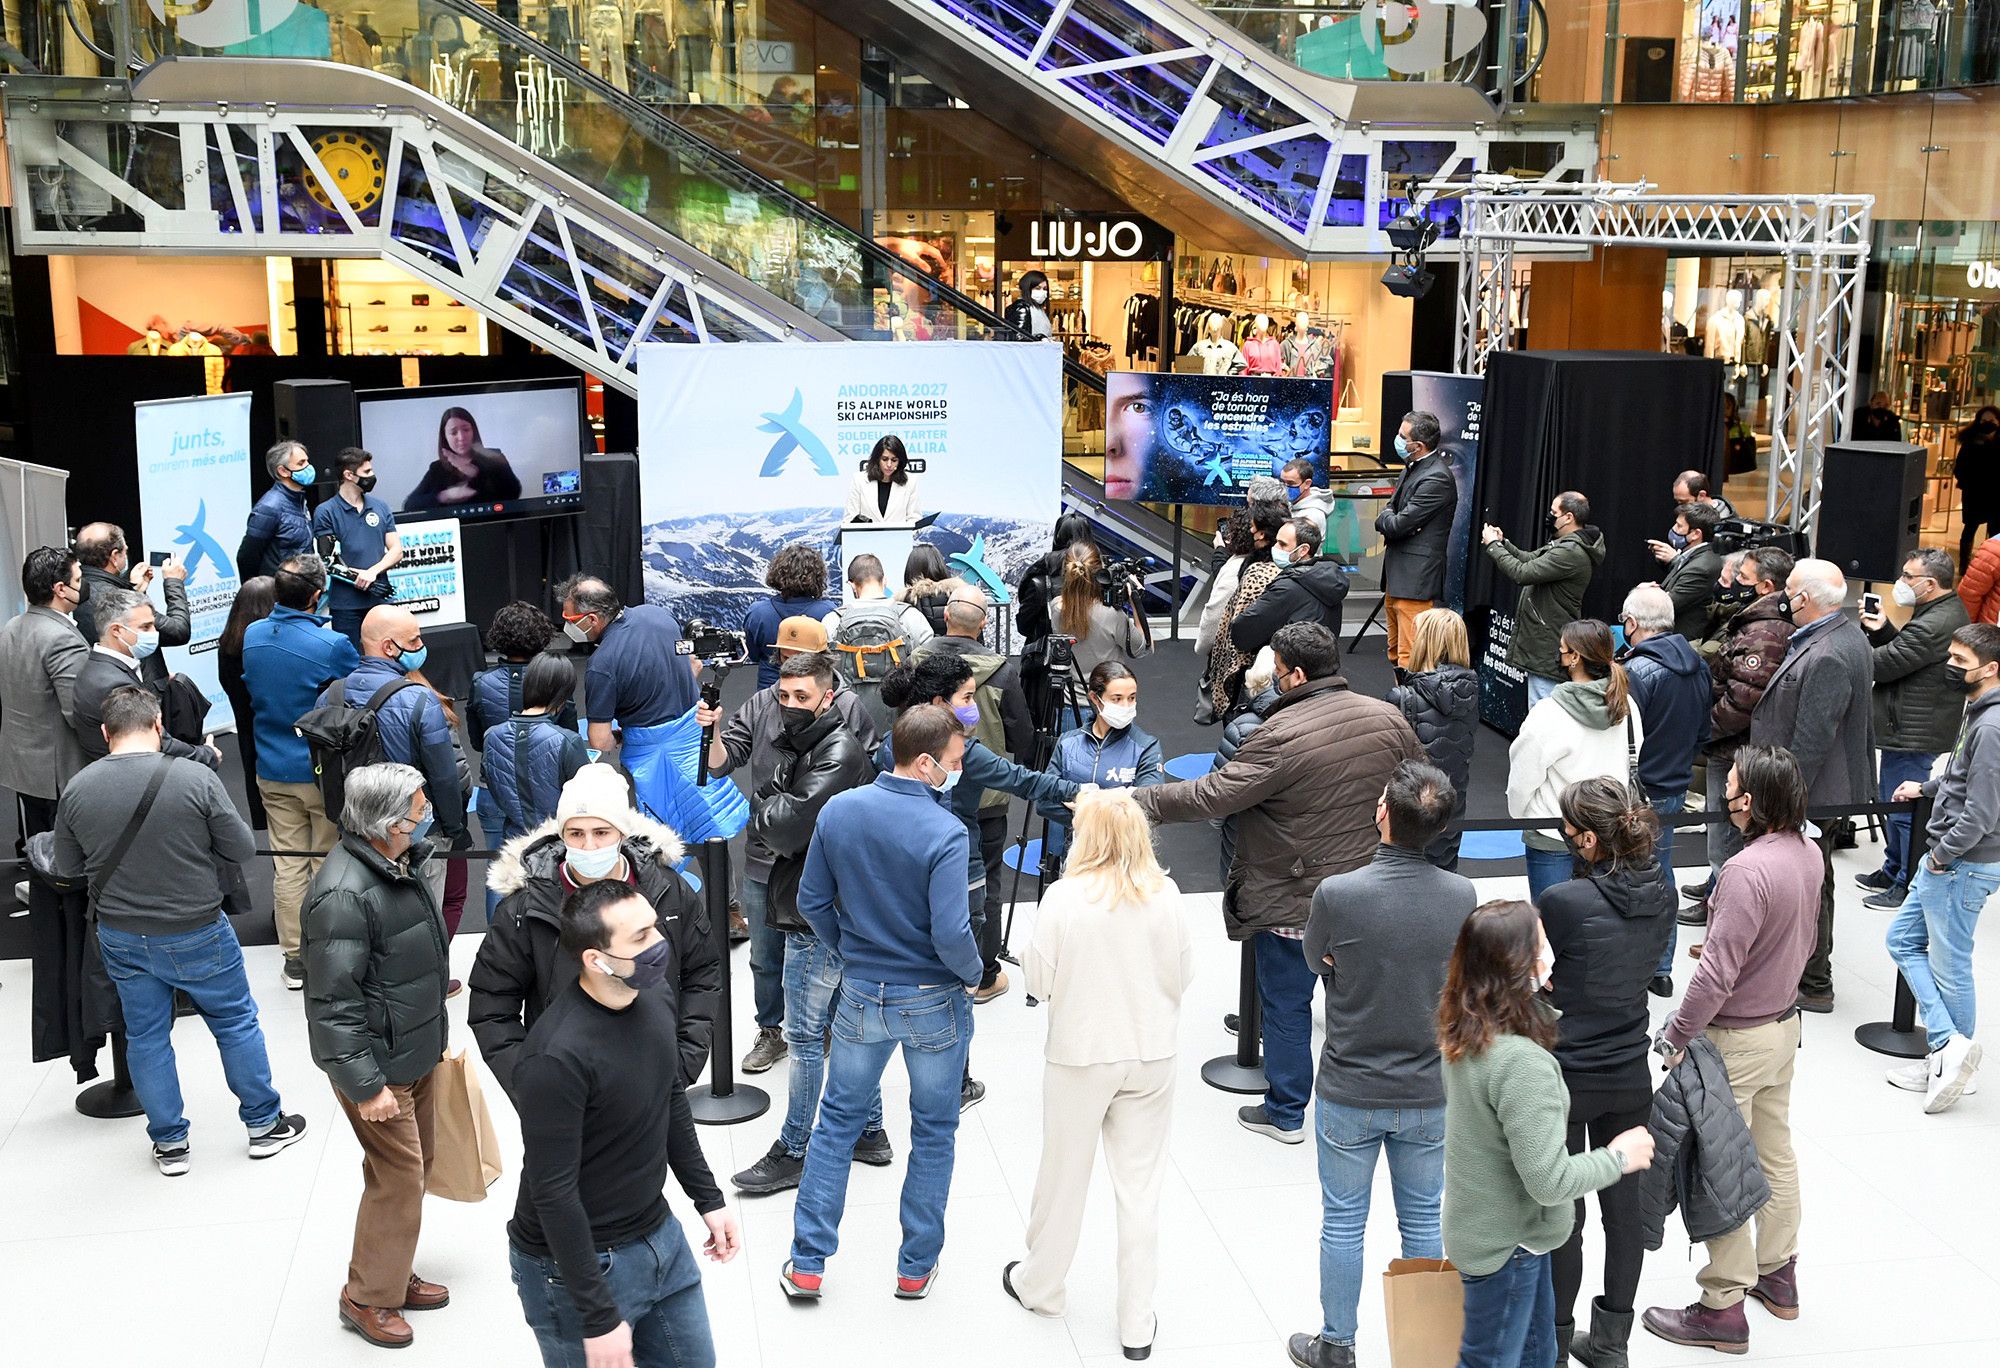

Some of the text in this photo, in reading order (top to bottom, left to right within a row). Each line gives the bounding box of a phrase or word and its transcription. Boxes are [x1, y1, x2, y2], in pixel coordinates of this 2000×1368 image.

[838, 383, 948, 398] ANDORRA 2027
[1231, 392, 1244, 402] és
[1245, 393, 1270, 403] hora
[837, 400, 948, 411] FIS ALPINE WORLD
[1211, 402, 1225, 411] de
[1260, 404, 1268, 413] a
[837, 411, 948, 421] SKI CHAMPIONSHIPS
[1213, 412, 1266, 422] encendre
[1204, 420, 1220, 430] les
[904, 429, 948, 441] TARTER
[170, 428, 225, 456] junts,
[419, 545, 455, 558] WORLD
